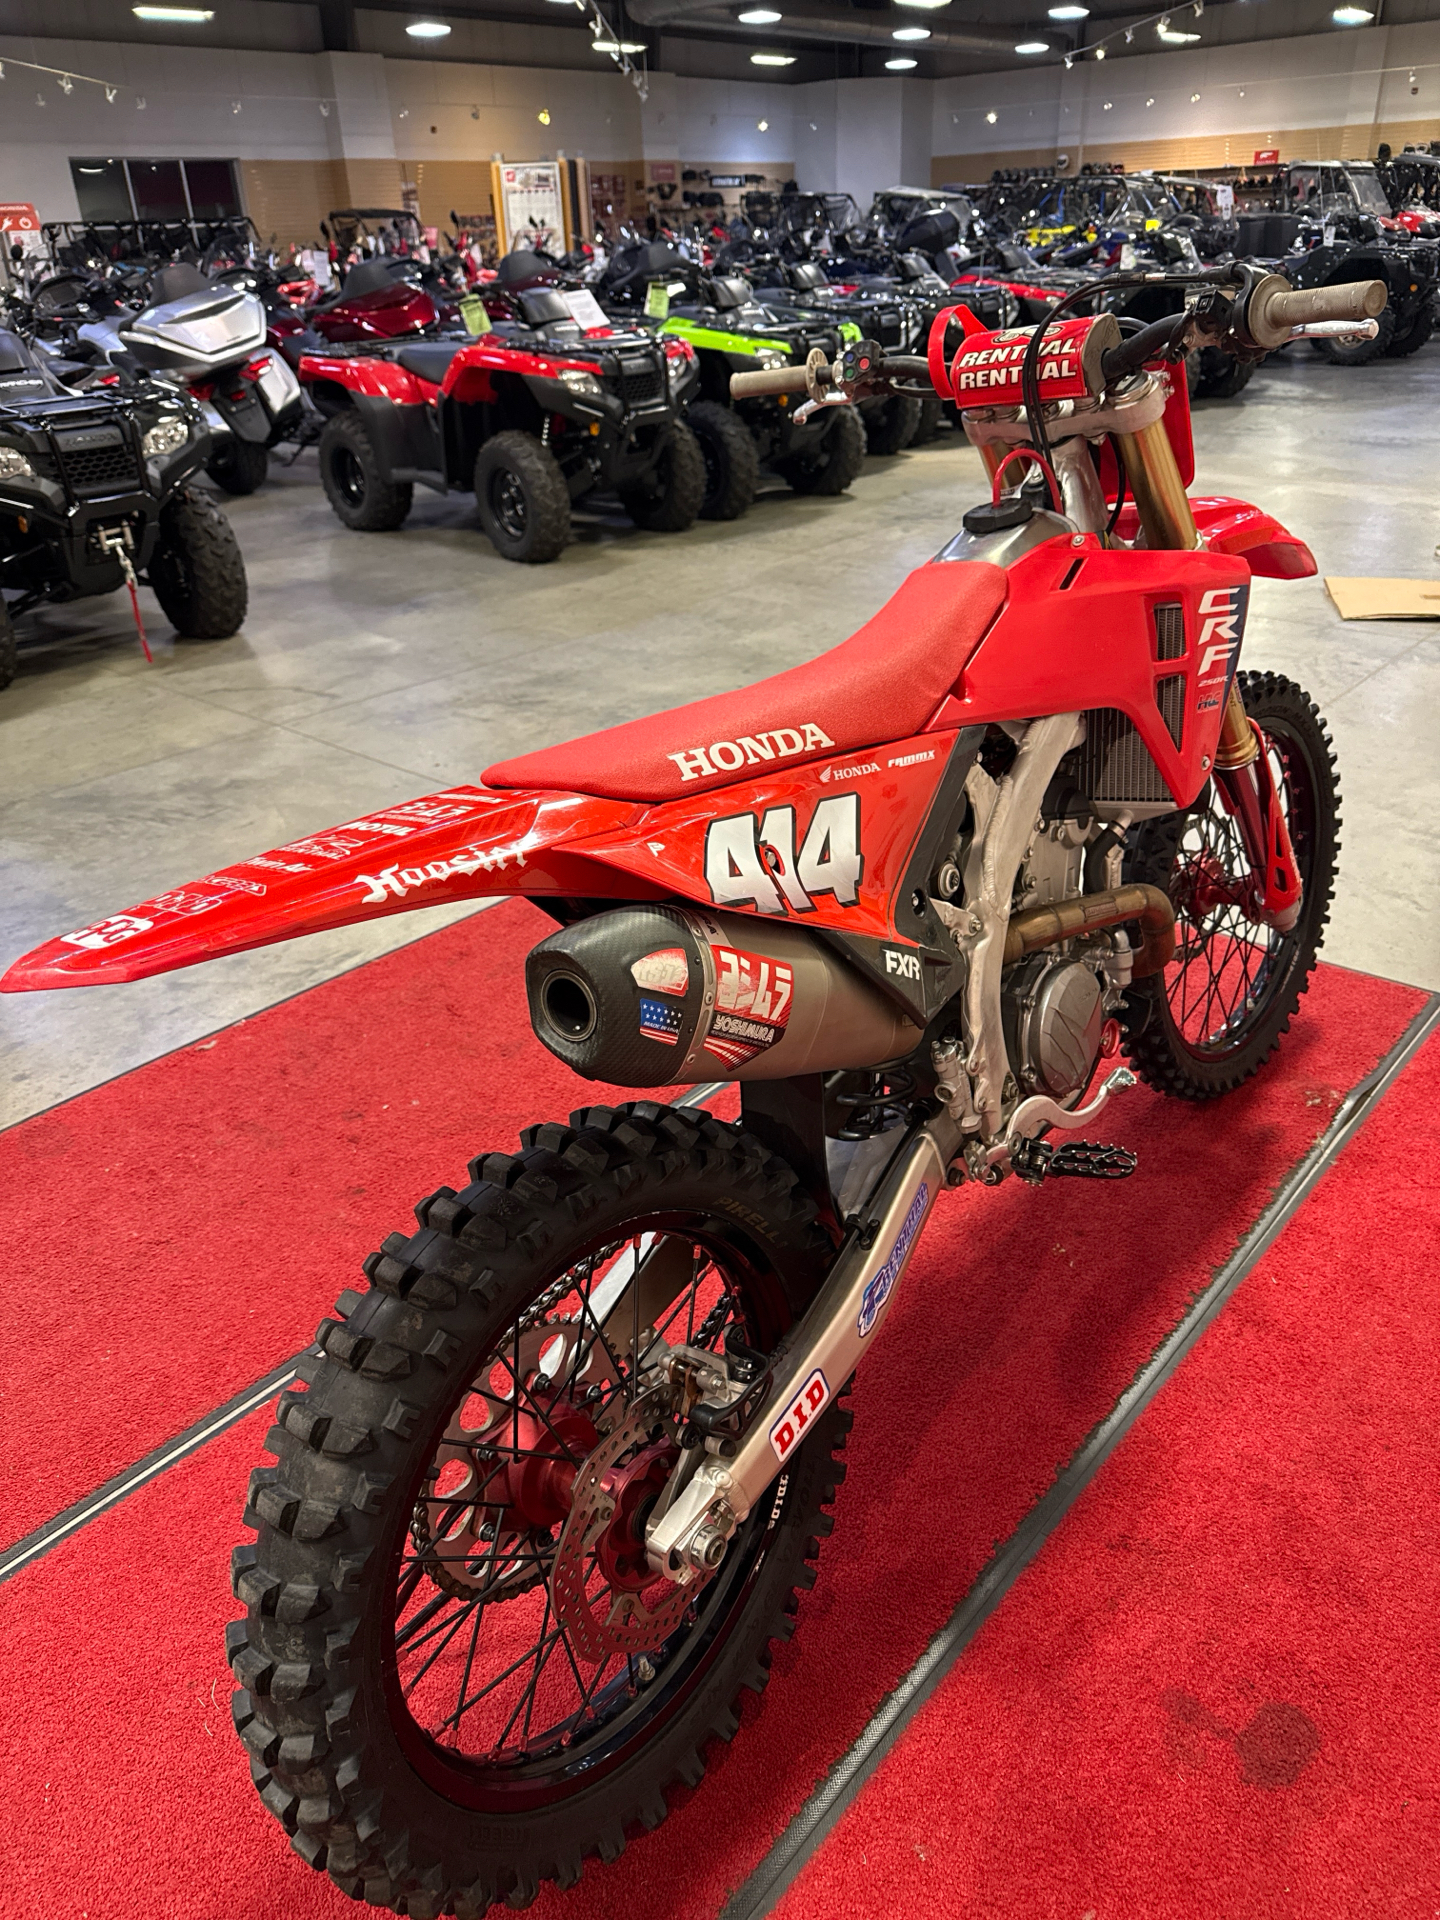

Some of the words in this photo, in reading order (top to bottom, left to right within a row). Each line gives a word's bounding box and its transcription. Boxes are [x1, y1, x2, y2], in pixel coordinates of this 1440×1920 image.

[960, 359, 1077, 390] RENTAL
[1197, 587, 1241, 676] CRF
[668, 723, 835, 781] HONDA
[833, 762, 881, 780] HONDA
[704, 791, 865, 915] 414
[882, 948, 920, 980] FXR
[713, 1014, 775, 1043] YOSHIMURA
